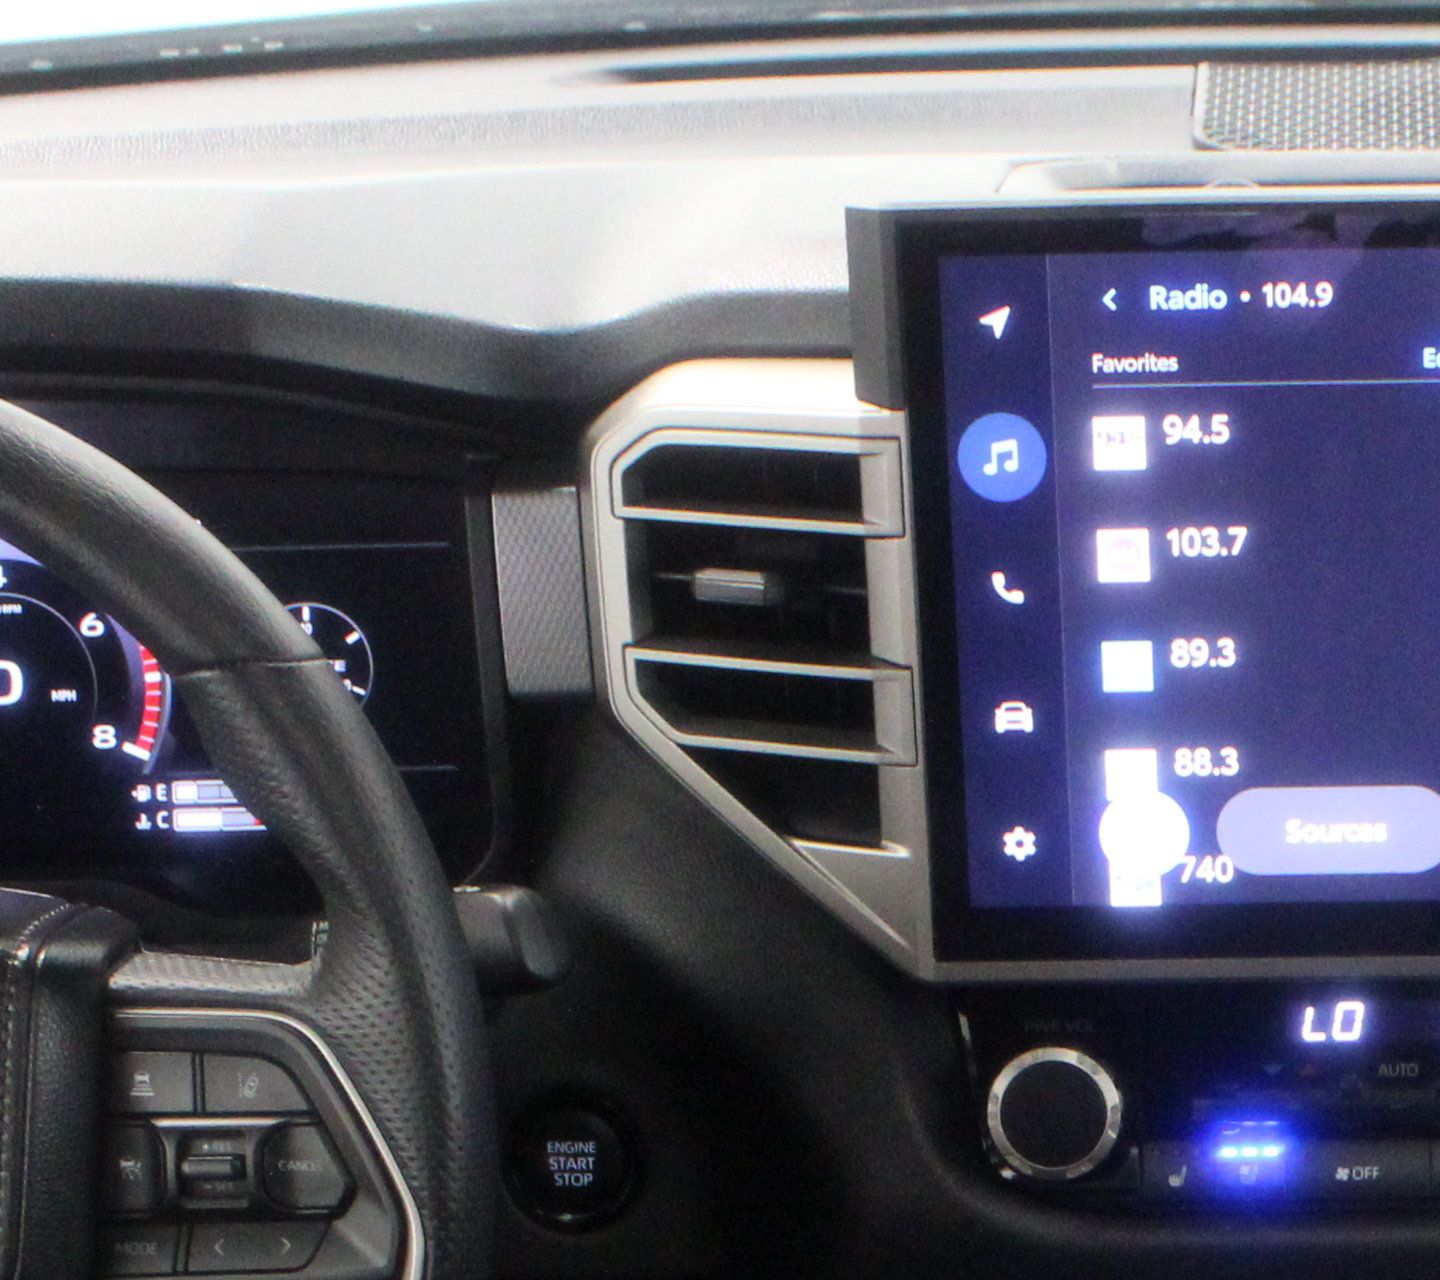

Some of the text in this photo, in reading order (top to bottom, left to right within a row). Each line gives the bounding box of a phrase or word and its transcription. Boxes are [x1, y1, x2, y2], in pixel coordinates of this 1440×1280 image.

[1149, 281, 1334, 310] Radio 104.9
[1092, 353, 1179, 374] Favorites
[1162, 414, 1230, 444] 94.5
[1167, 526, 1248, 557] 103.7
[79, 613, 105, 637] 6
[1170, 637, 1237, 668] 89.3
[50, 689, 77, 702] MPH
[92, 724, 117, 749] 8
[1174, 746, 1241, 777] 88.3
[156, 783, 168, 801] E
[156, 810, 169, 829] C
[1285, 818, 1389, 845] Sources
[1179, 854, 1234, 884] 740
[1301, 1000, 1365, 1042] LO
[1377, 1063, 1419, 1078] AUTO
[546, 1141, 597, 1154] ENGINE
[548, 1156, 596, 1170] START
[1350, 1166, 1381, 1181] OFF
[554, 1173, 593, 1186] STOP
